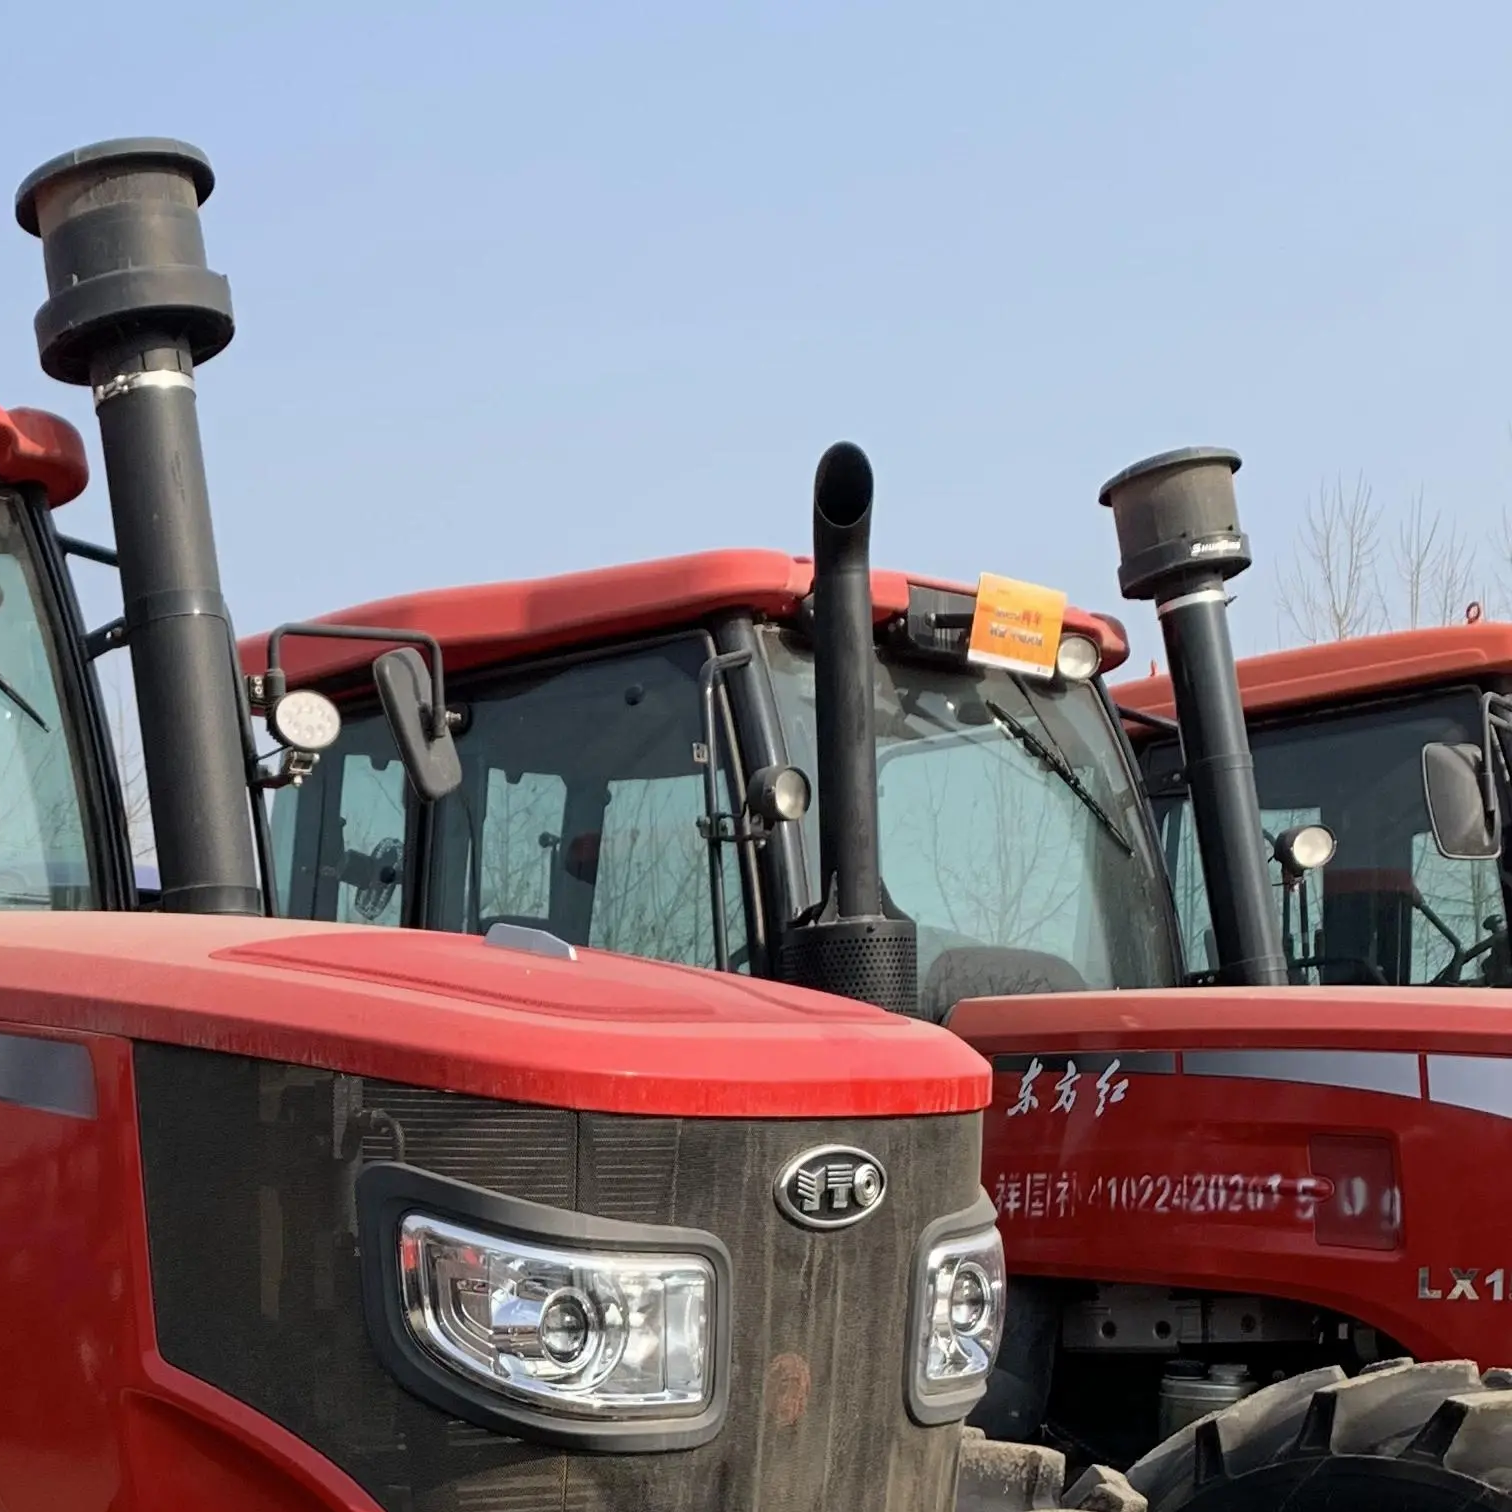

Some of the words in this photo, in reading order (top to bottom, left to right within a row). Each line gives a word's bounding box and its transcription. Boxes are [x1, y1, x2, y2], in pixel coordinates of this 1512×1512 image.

[1006, 1057, 1130, 1118] 东方红
[797, 1162, 881, 1212] YTO
[1417, 1265, 1512, 1301] LX1
